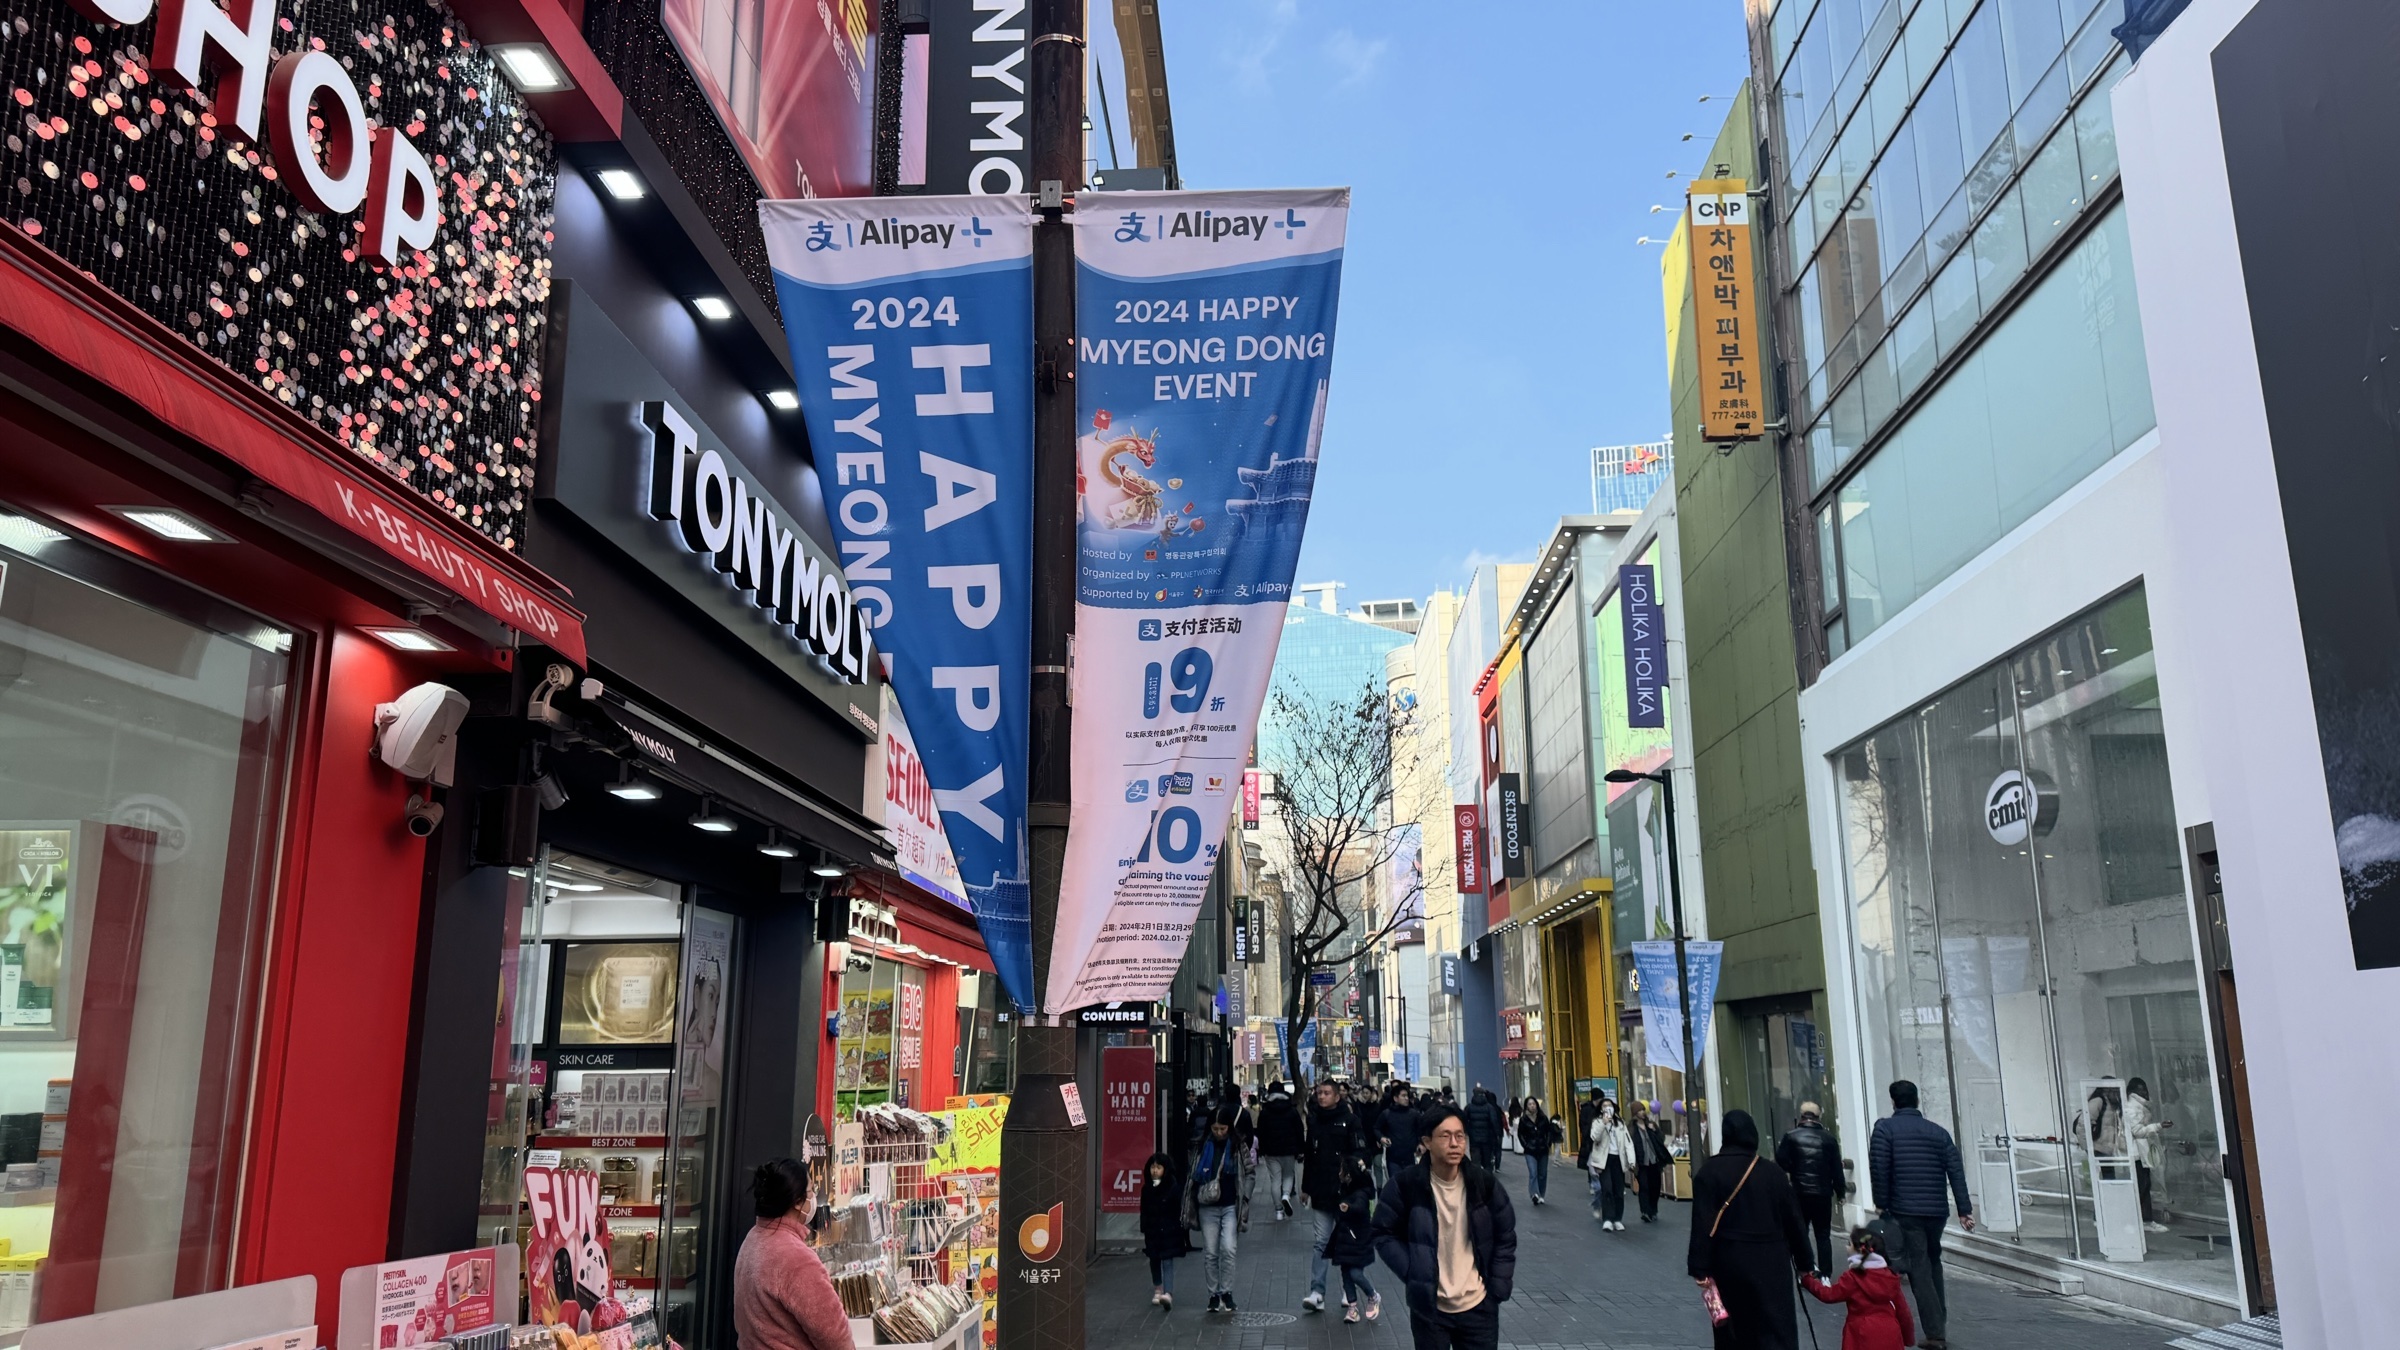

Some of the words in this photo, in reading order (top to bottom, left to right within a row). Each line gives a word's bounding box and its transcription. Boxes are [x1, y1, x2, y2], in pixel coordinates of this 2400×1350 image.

[88, 0, 440, 267] HOP
[1698, 202, 1741, 217] CNP
[860, 217, 955, 249] Alipay
[1169, 210, 1268, 242] Alipay
[851, 296, 960, 330] 2024
[1115, 300, 1189, 323] 2024
[1199, 296, 1299, 322] HAPPY
[1080, 337, 1225, 365] MYEONG
[1235, 332, 1326, 361] DONG
[1154, 372, 1257, 401] EVENT
[1712, 410, 1757, 420] 777-2488
[1625, 460, 1645, 475] SK
[656, 400, 872, 685] TONYMOLY
[1082, 547, 1115, 559] Hosted
[1119, 551, 1132, 561] by
[335, 480, 487, 598] K-BEAUTY
[493, 579, 559, 638] SHOP
[1082, 567, 1133, 580] Organized
[1137, 571, 1150, 581] by
[910, 343, 1004, 843] HAPPY
[1082, 586, 1133, 599] Supported
[1136, 590, 1149, 600] by
[1256, 582, 1288, 595] Alipay
[1630, 574, 1650, 641] HOLIKA
[1164, 617, 1242, 638] 支付宝活动
[1634, 648, 1655, 716] HOLIKA
[1505, 791, 1519, 859] SKINFOOD
[1165, 872, 1182, 880] the
[1116, 934, 1140, 943] period:
[1236, 926, 1245, 959] LUSH
[1444, 960, 1455, 988] MLB
[1231, 969, 1240, 1018] LANEIGE
[1082, 1011, 1144, 1021] CONVERSE
[559, 1054, 584, 1065] SKIN
[586, 1054, 614, 1065] CARE
[1249, 1033, 1257, 1062] ETUDE
[1107, 1082, 1150, 1095] JUNO
[1111, 1096, 1145, 1108] HAIR
[965, 1108, 1003, 1147] SALE
[592, 1138, 610, 1147] BEST
[612, 1138, 636, 1147] ZONE
[1113, 1169, 1142, 1193] 4F
[526, 1172, 599, 1241] FUN
[608, 1207, 633, 1216] ZONE
[383, 1280, 413, 1292] COLLAGEN
[414, 1275, 427, 1285] 400
[1019, 1268, 1061, 1283] 서울중구
